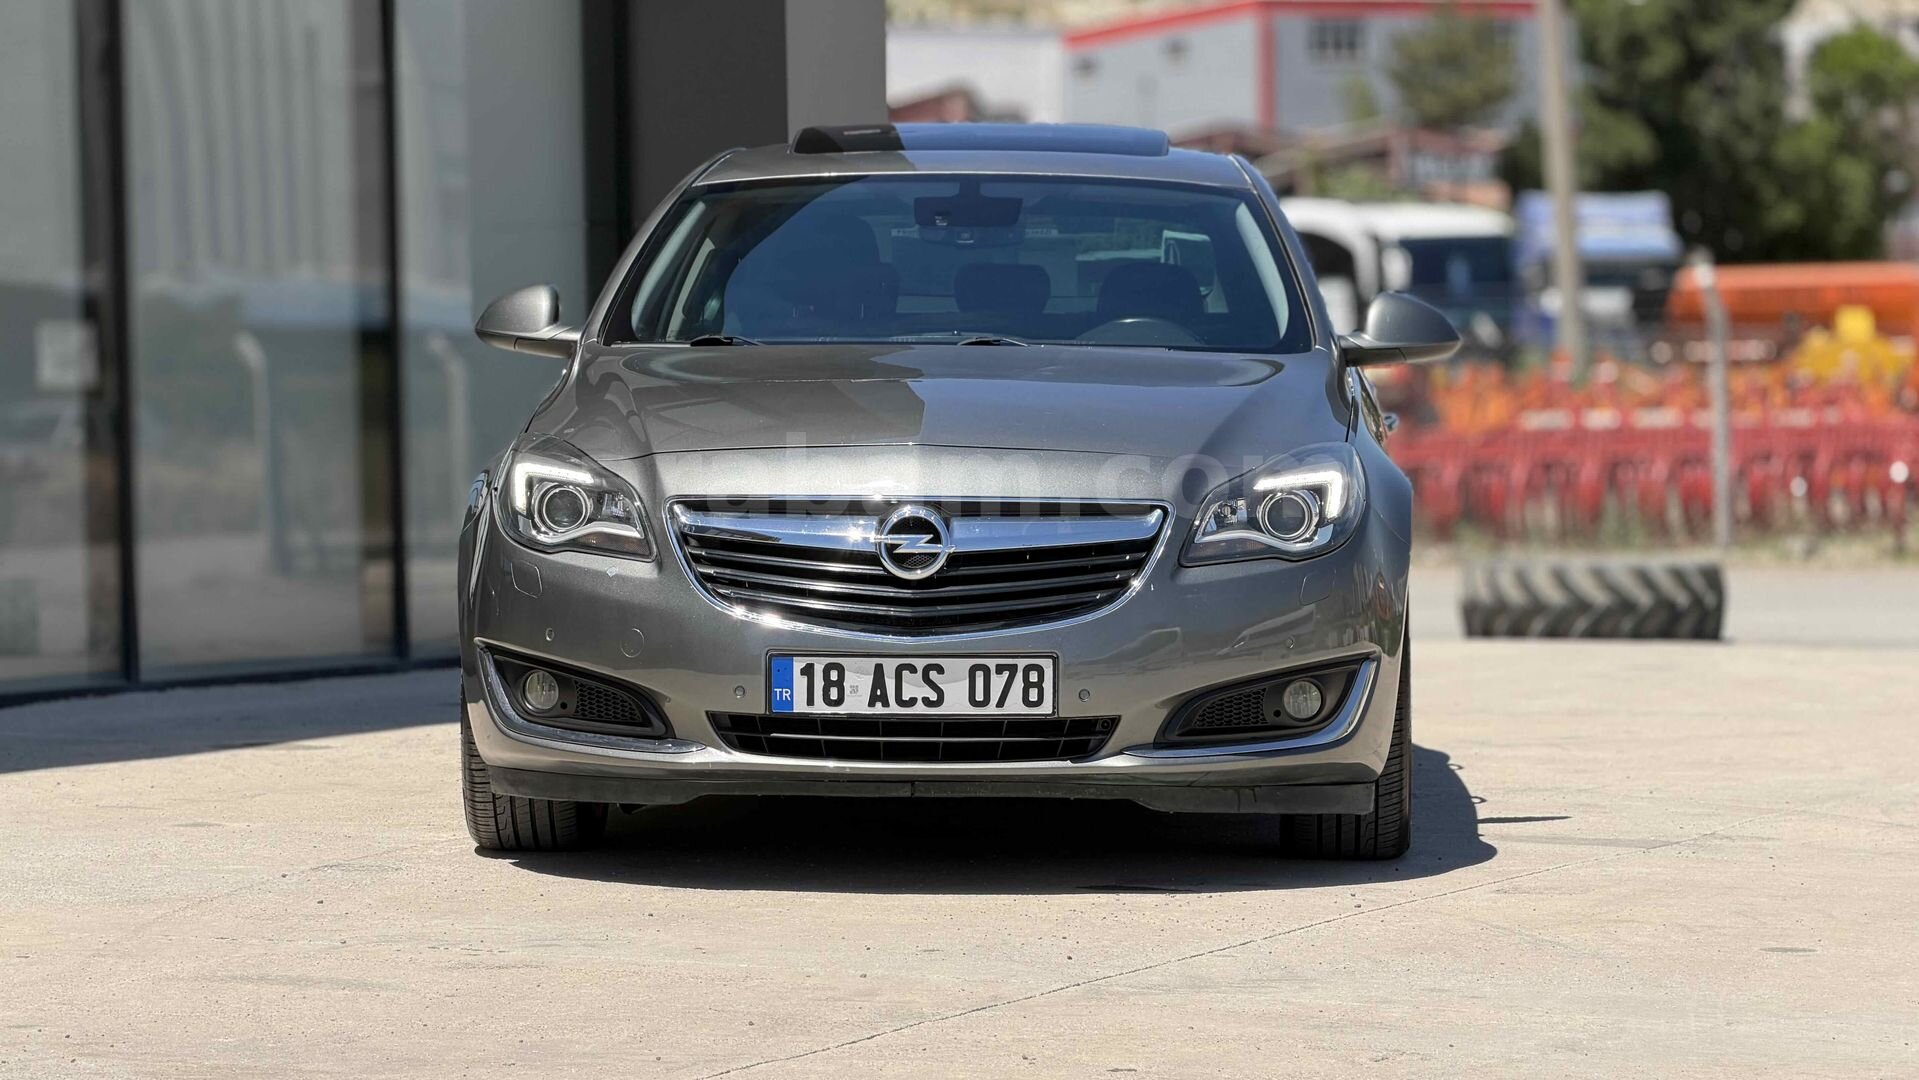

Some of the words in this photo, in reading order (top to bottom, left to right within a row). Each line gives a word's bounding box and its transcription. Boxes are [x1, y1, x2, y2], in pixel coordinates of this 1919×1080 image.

[774, 688, 791, 701] TR
[799, 662, 846, 707] 18
[867, 663, 945, 708] ACS
[968, 663, 1045, 708] 078
